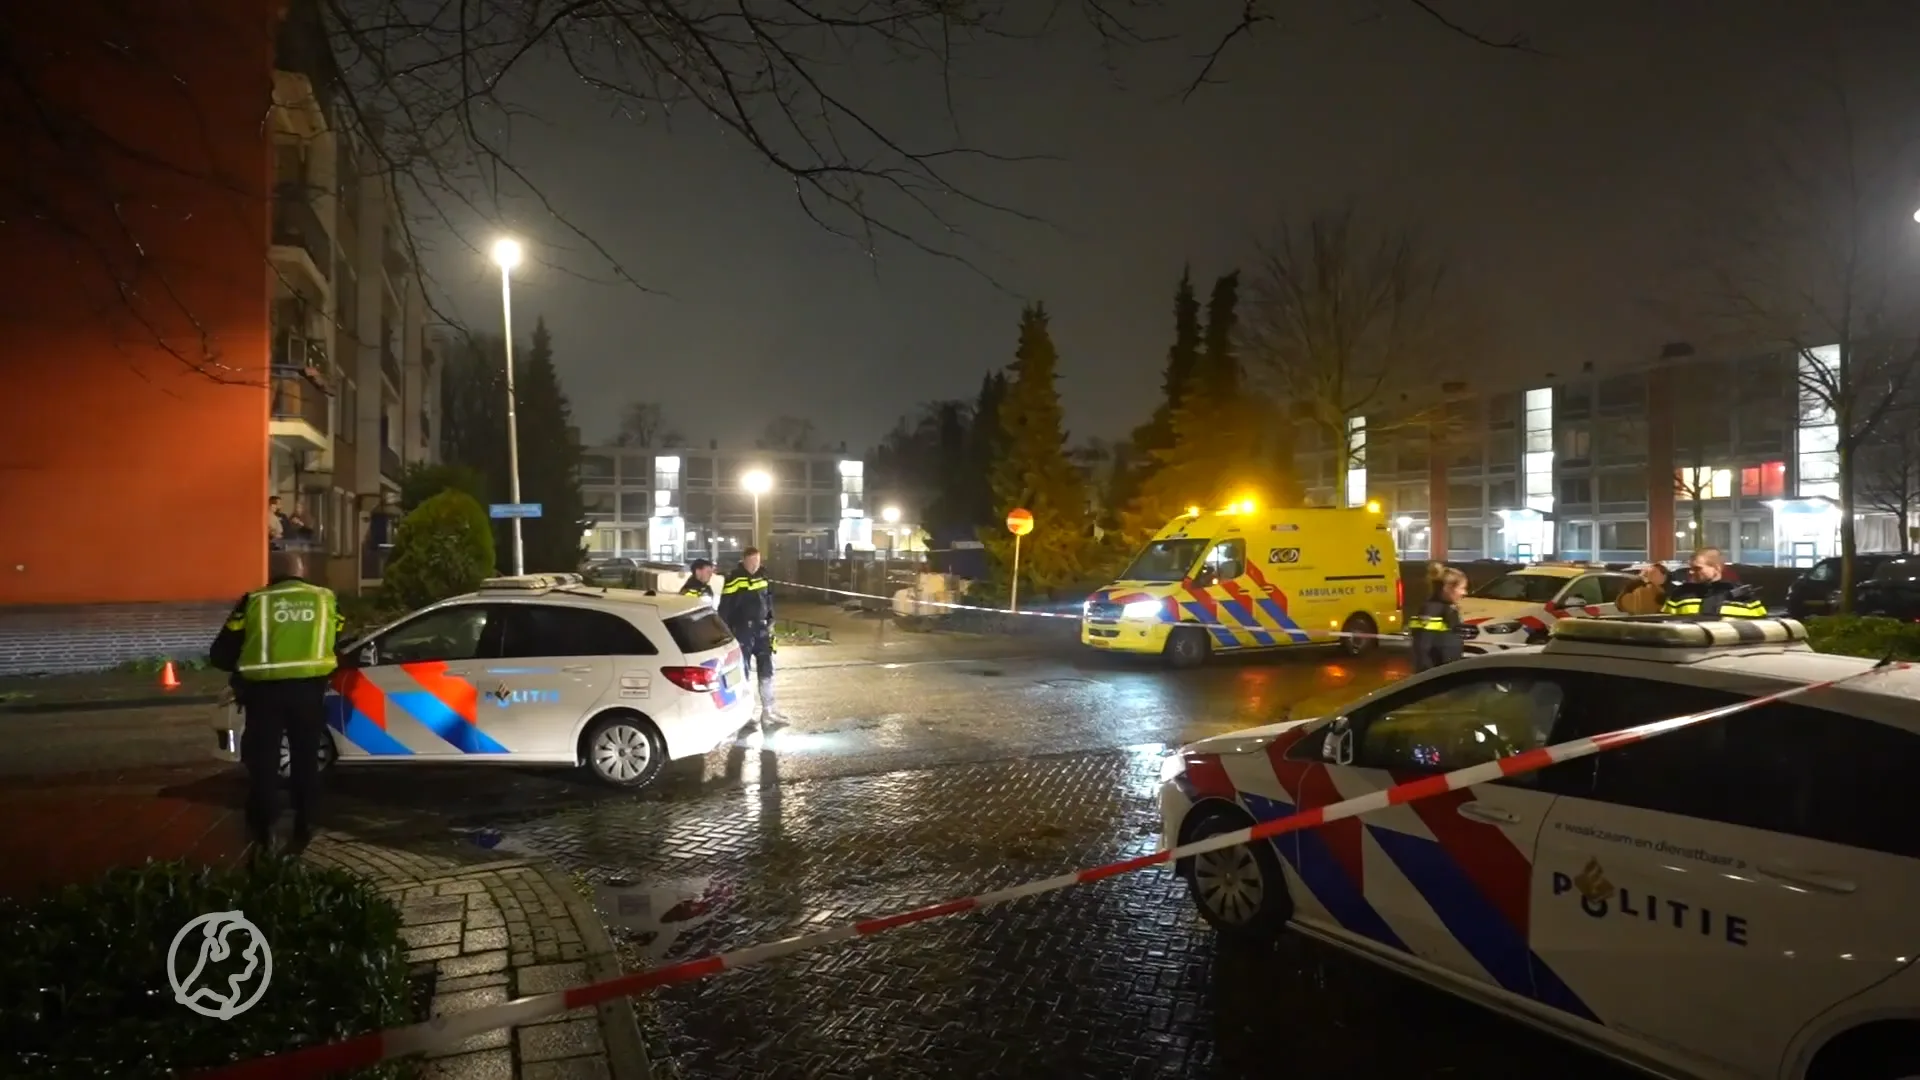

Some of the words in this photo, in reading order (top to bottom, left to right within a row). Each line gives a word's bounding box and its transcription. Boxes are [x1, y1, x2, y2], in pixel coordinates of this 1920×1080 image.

[1298, 586, 1356, 597] AMBULANCE
[274, 609, 315, 623] OVD
[1565, 823, 1634, 845] waakzaam
[1635, 838, 1653, 850] en
[1655, 840, 1734, 867] dienstbaar
[1553, 871, 1748, 947] POLITIE
